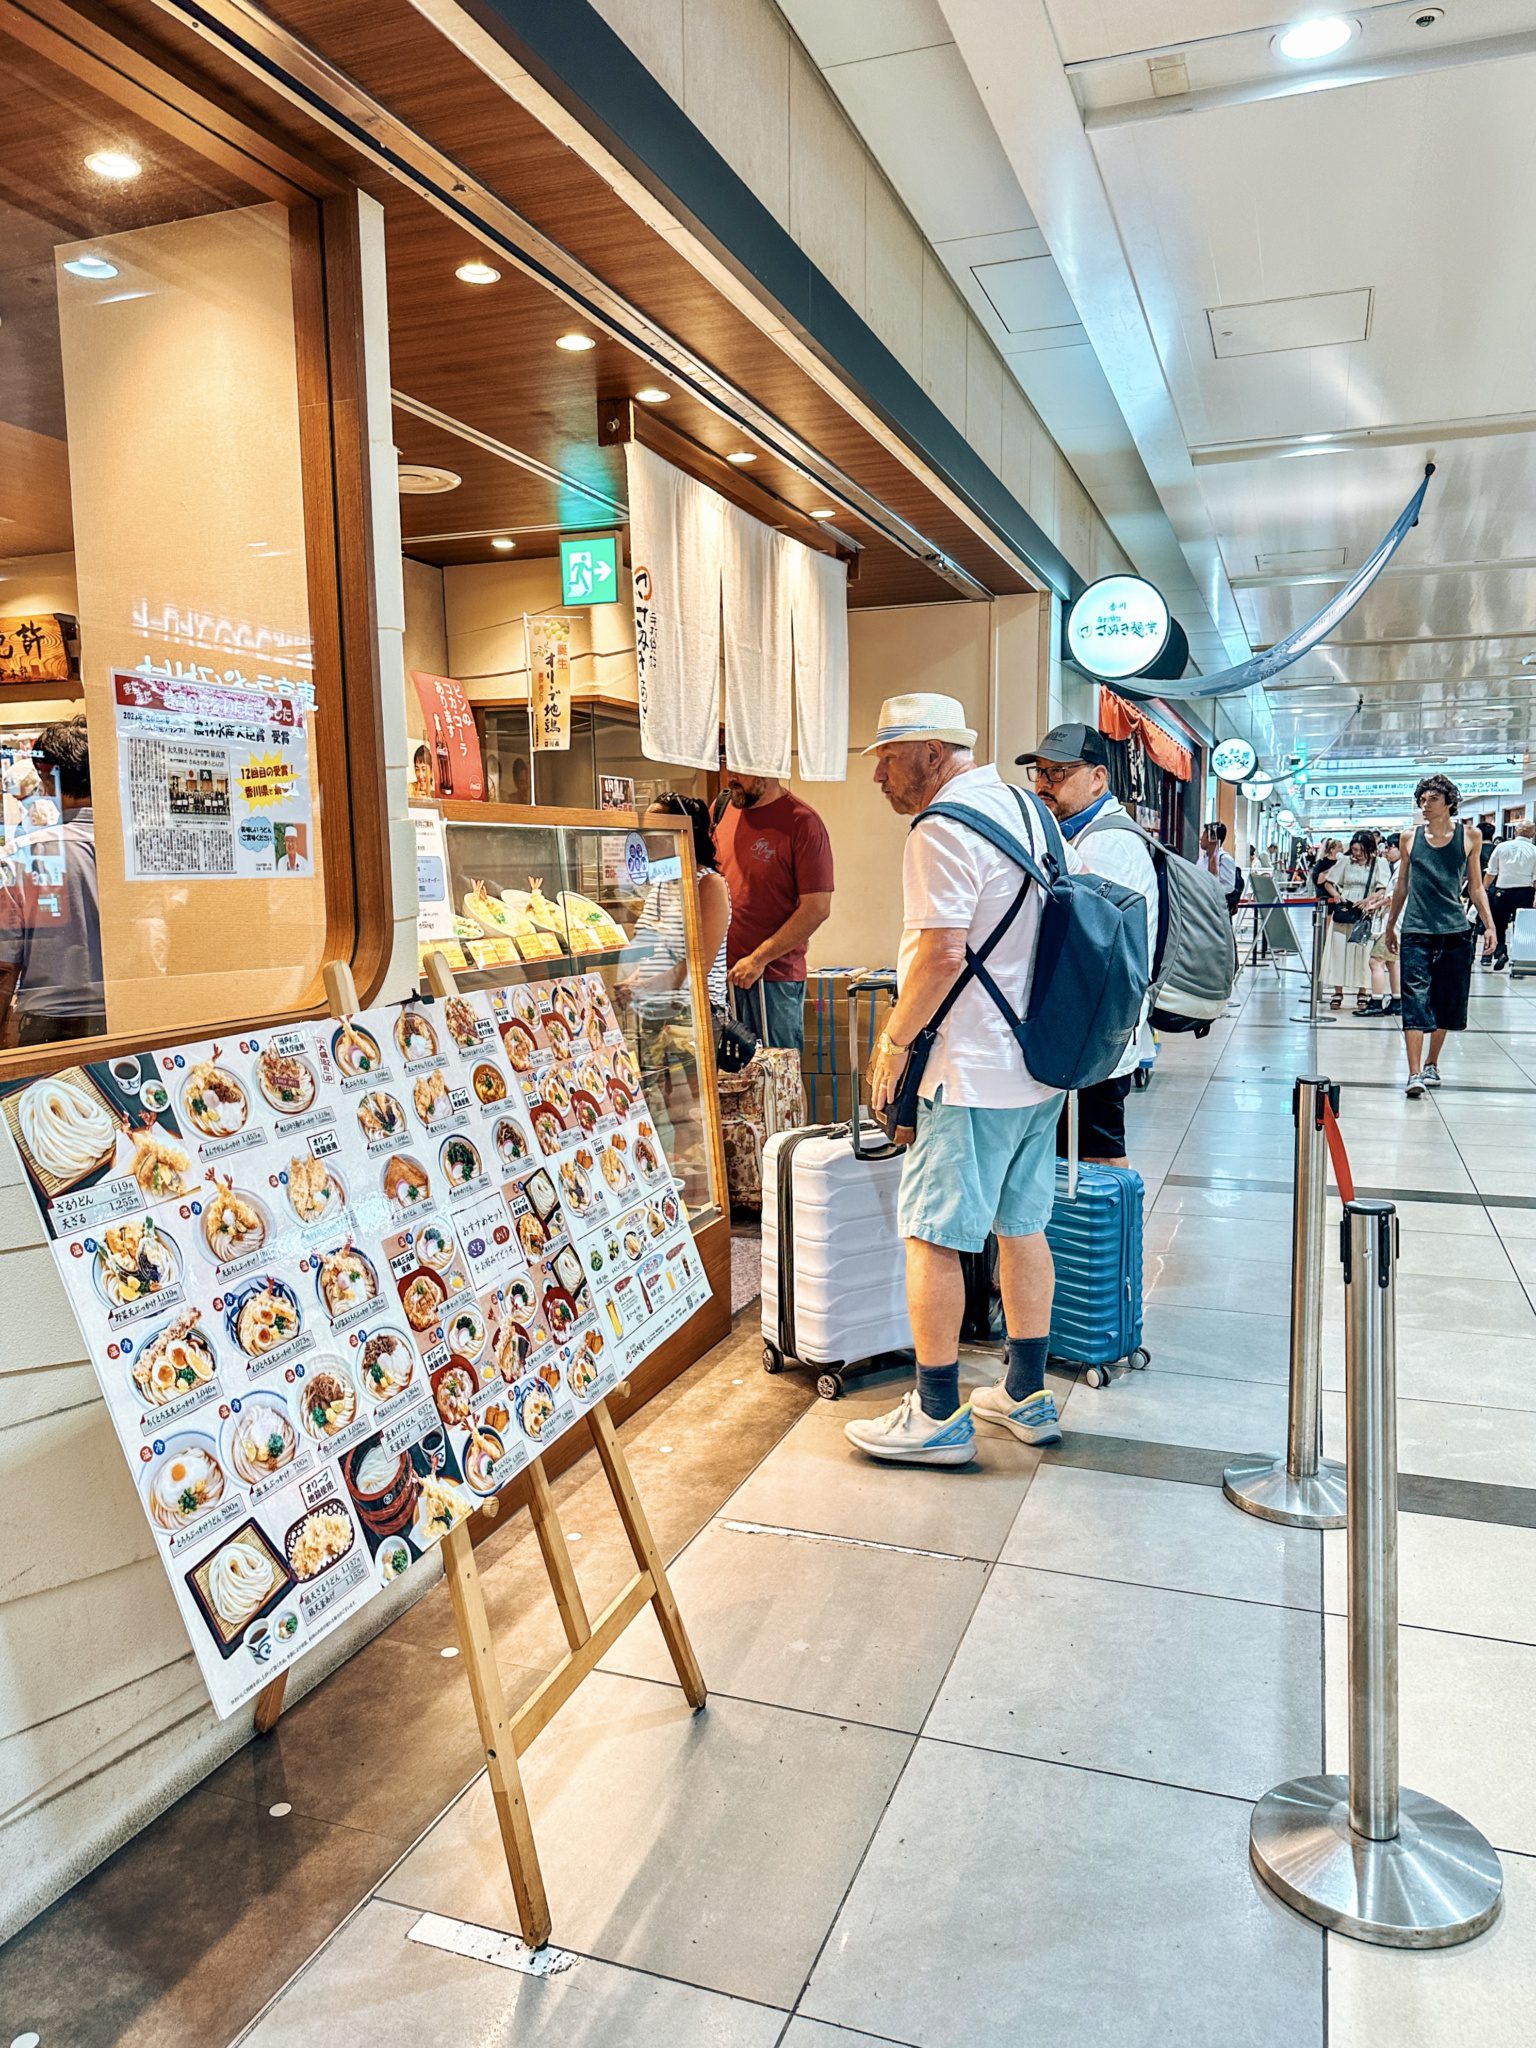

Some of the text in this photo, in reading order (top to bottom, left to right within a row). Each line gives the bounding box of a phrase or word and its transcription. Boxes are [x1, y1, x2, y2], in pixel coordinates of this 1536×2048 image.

[1110, 602, 1126, 611] 香川
[434, 680, 455, 738] あります
[453, 685, 472, 726] ビンの
[442, 683, 468, 757] コカ・コーラ
[271, 728, 290, 746] 受賞
[312, 1134, 334, 1147] オリーブ
[110, 1181, 134, 1195] 619円
[56, 1194, 94, 1213] ざるうどん
[109, 1196, 140, 1213] 1,255円
[61, 1213, 87, 1231] 天ざる
[461, 1210, 504, 1237] おすすめセット
[469, 1242, 485, 1256] ざる
[114, 1289, 178, 1323] 野菜天ぶっかけ 1,119円
[147, 1396, 195, 1427] ちくとろ玉天ぶっかけ
[385, 1416, 416, 1441] 釜あげうどん
[390, 1432, 410, 1453] 天釜あげ
[254, 1457, 308, 1499] 温玉ぶっかけ 700円
[304, 1471, 329, 1493] オリーブ
[176, 1501, 240, 1549] とろろぶっかけうどん 800円
[304, 1572, 341, 1607] 鶏天ざるうどん
[308, 1590, 337, 1618] 鶏天釜あげ
